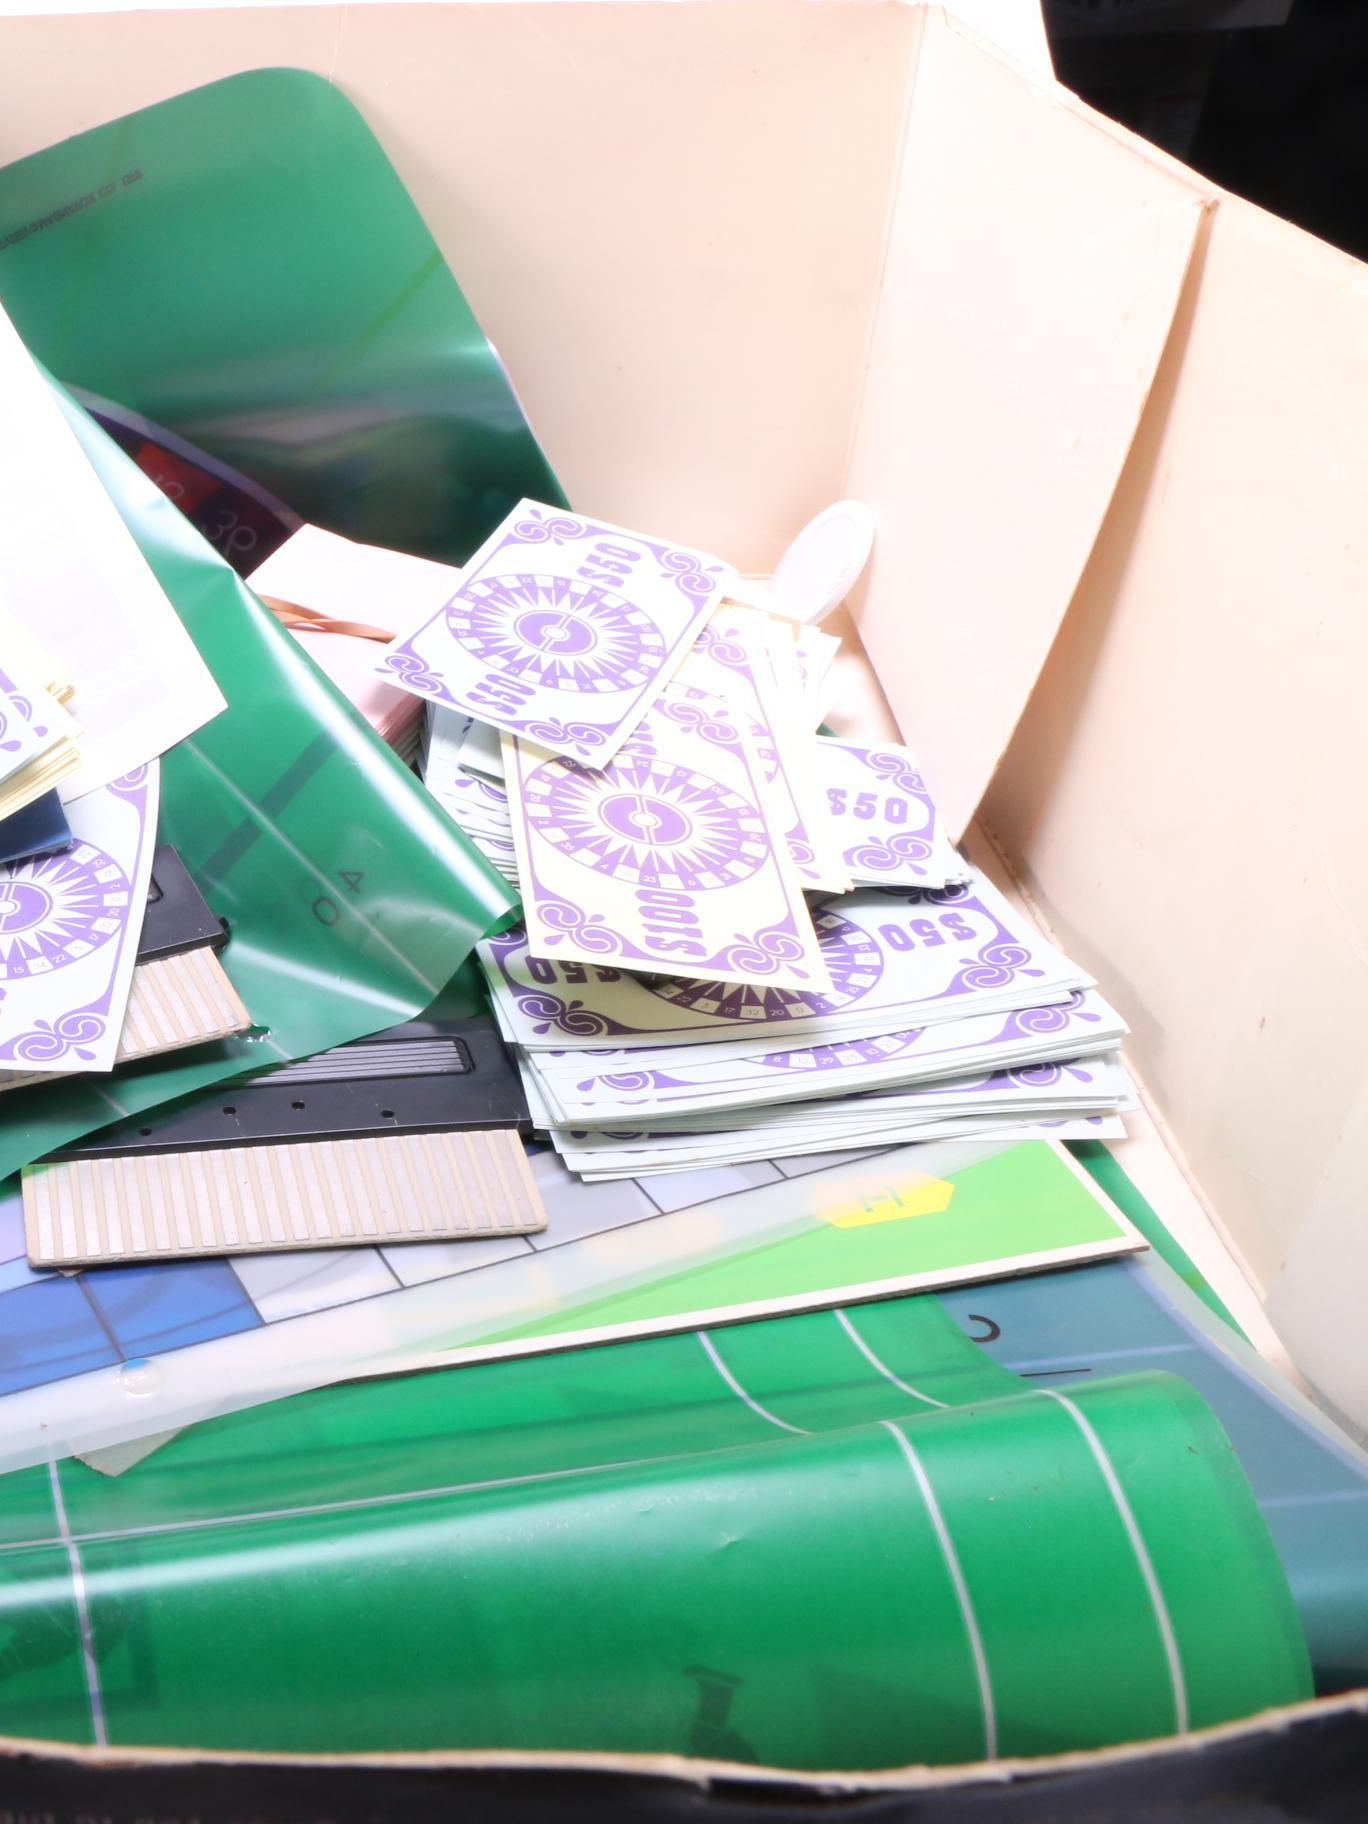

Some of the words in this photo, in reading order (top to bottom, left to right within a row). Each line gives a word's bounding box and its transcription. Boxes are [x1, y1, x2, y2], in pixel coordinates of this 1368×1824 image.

[576, 543, 642, 590] $50
[466, 673, 537, 717] $50
[826, 787, 908, 825] $50
[638, 889, 707, 958] $100
[877, 912, 978, 954] $50
